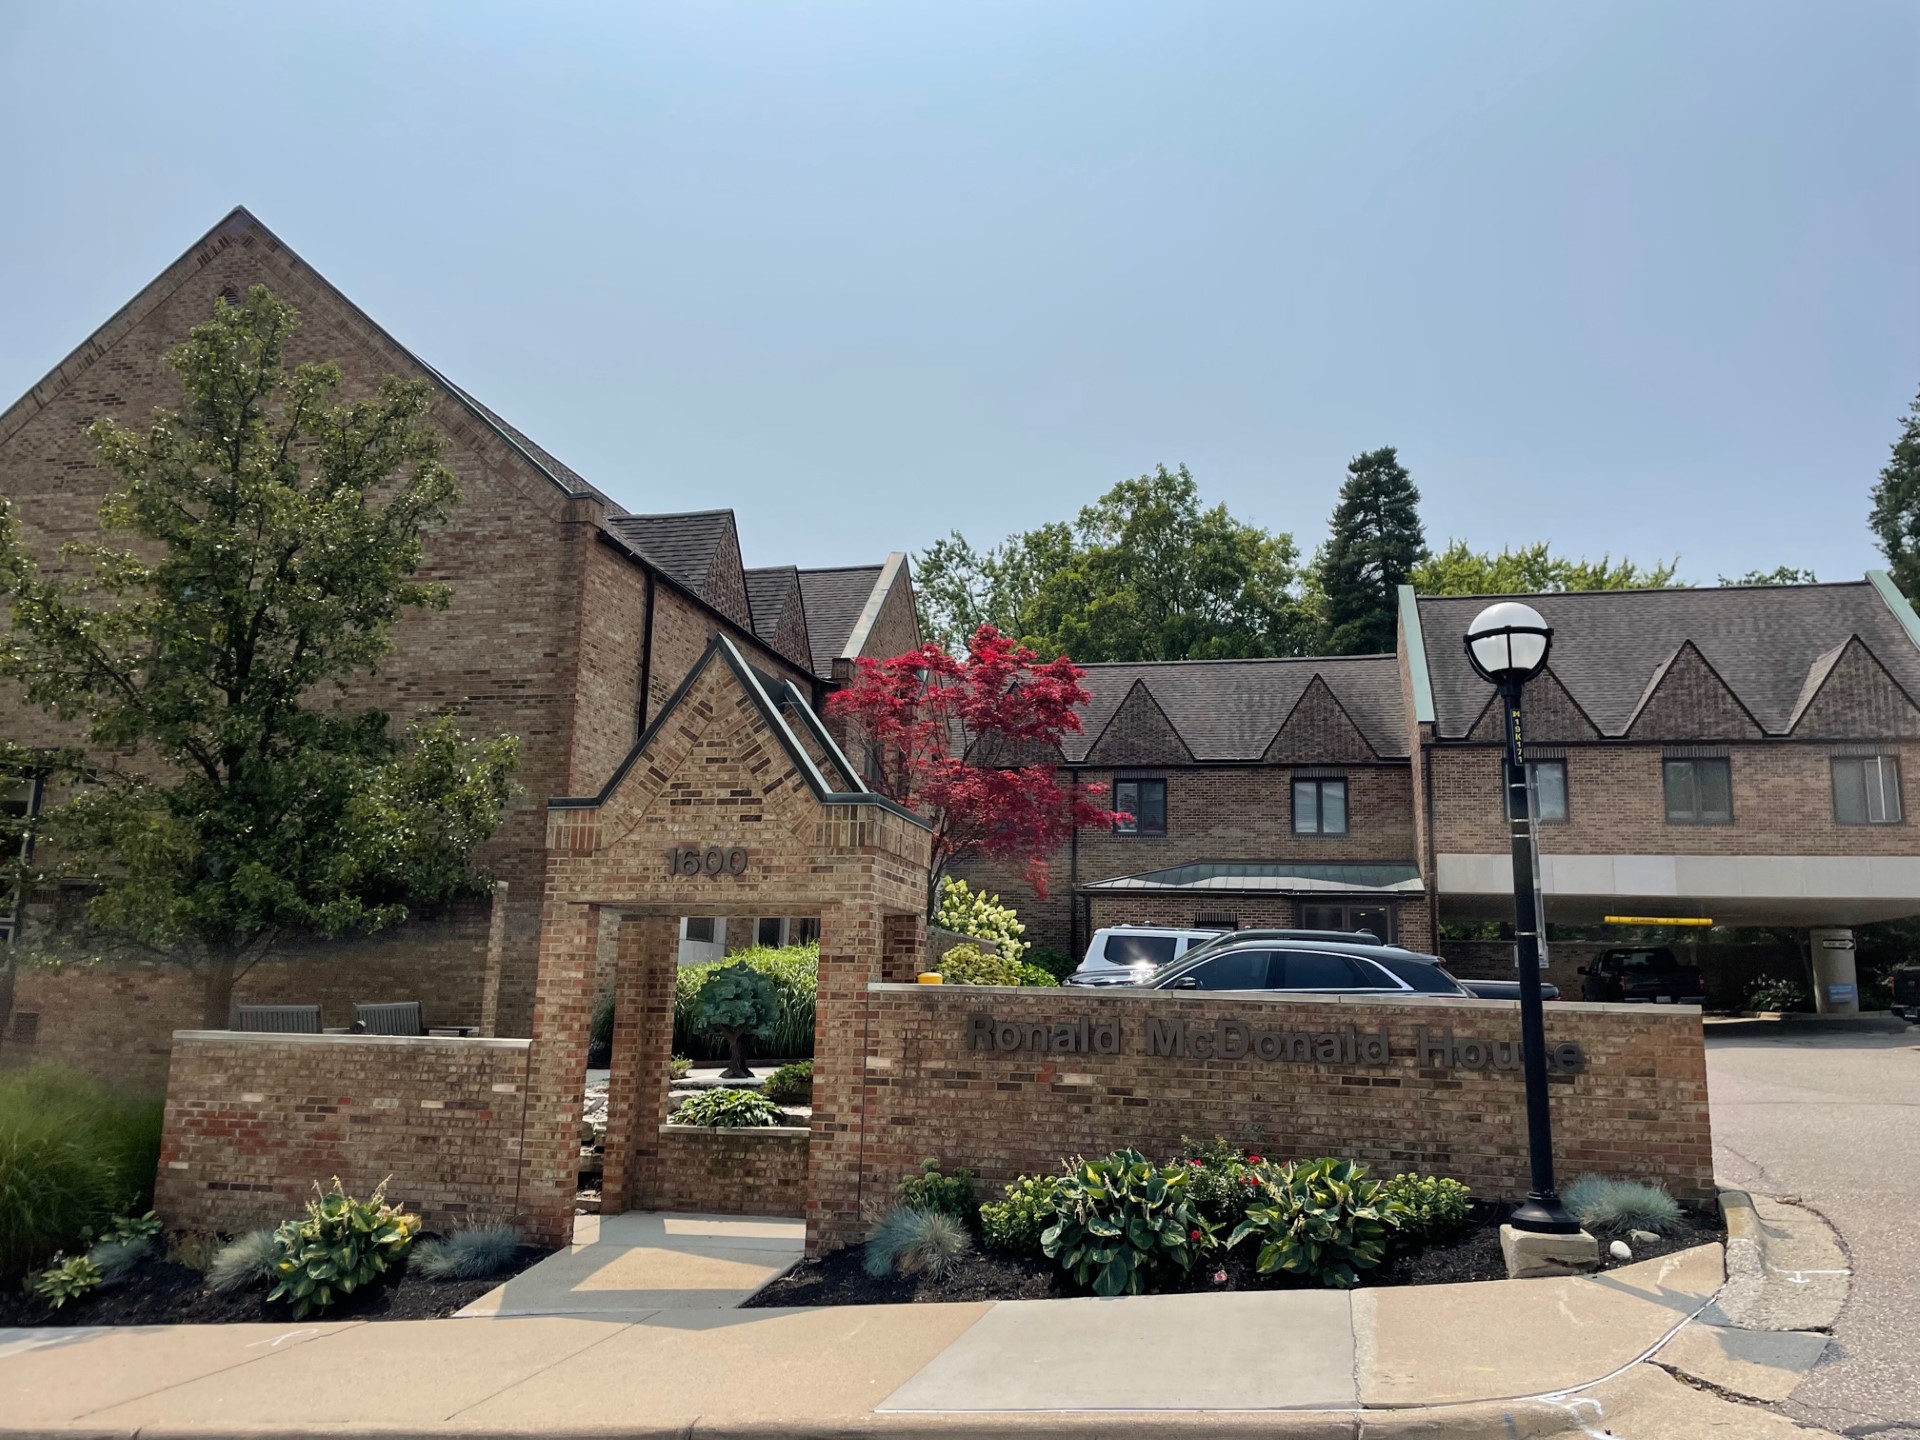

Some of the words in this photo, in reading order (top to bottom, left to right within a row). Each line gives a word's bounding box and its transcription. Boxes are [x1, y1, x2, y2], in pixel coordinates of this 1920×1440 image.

[666, 846, 748, 877] 1600
[966, 1013, 1121, 1055] Ronald
[1146, 1016, 1390, 1066] McDonald
[1417, 1025, 1585, 1074] Houe
